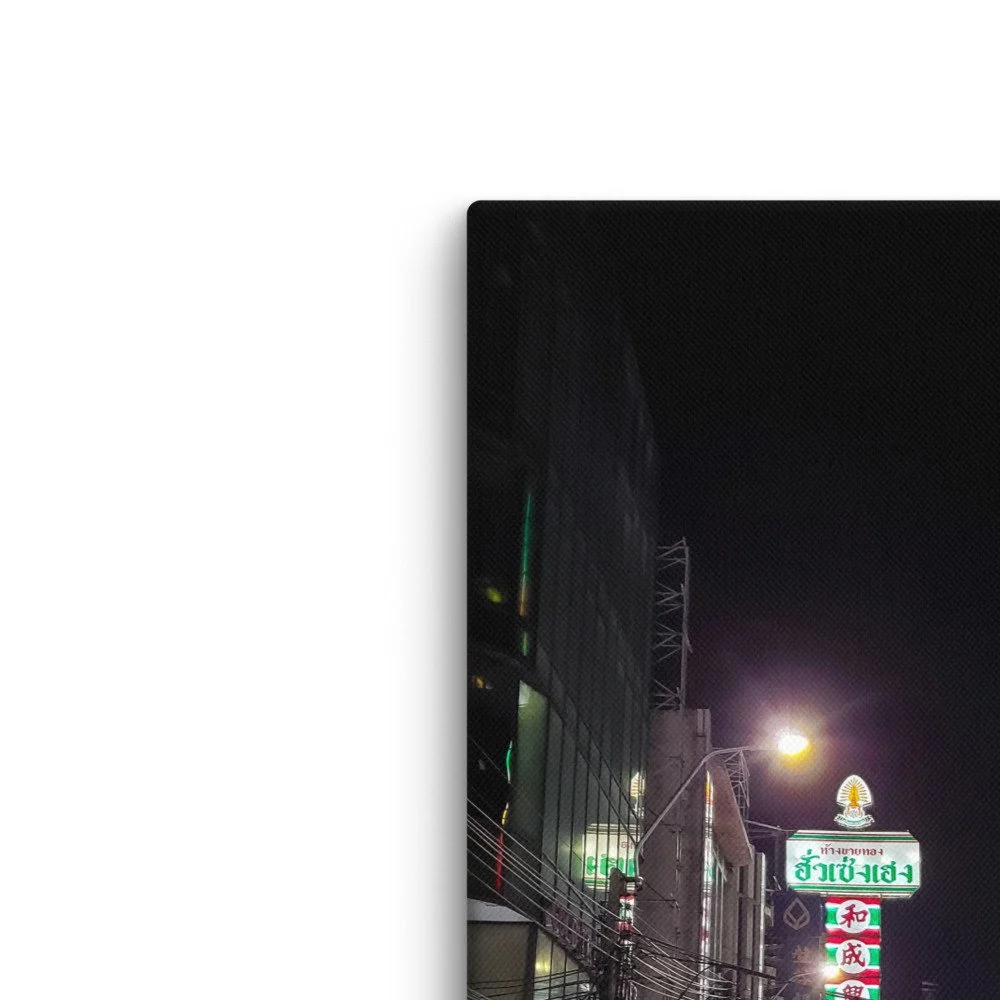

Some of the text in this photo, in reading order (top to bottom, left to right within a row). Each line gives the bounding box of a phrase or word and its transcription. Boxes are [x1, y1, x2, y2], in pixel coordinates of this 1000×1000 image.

[820, 843, 884, 856] ห้างขายทอง
[794, 848, 914, 884] ฮั่วเซ่งเฮง
